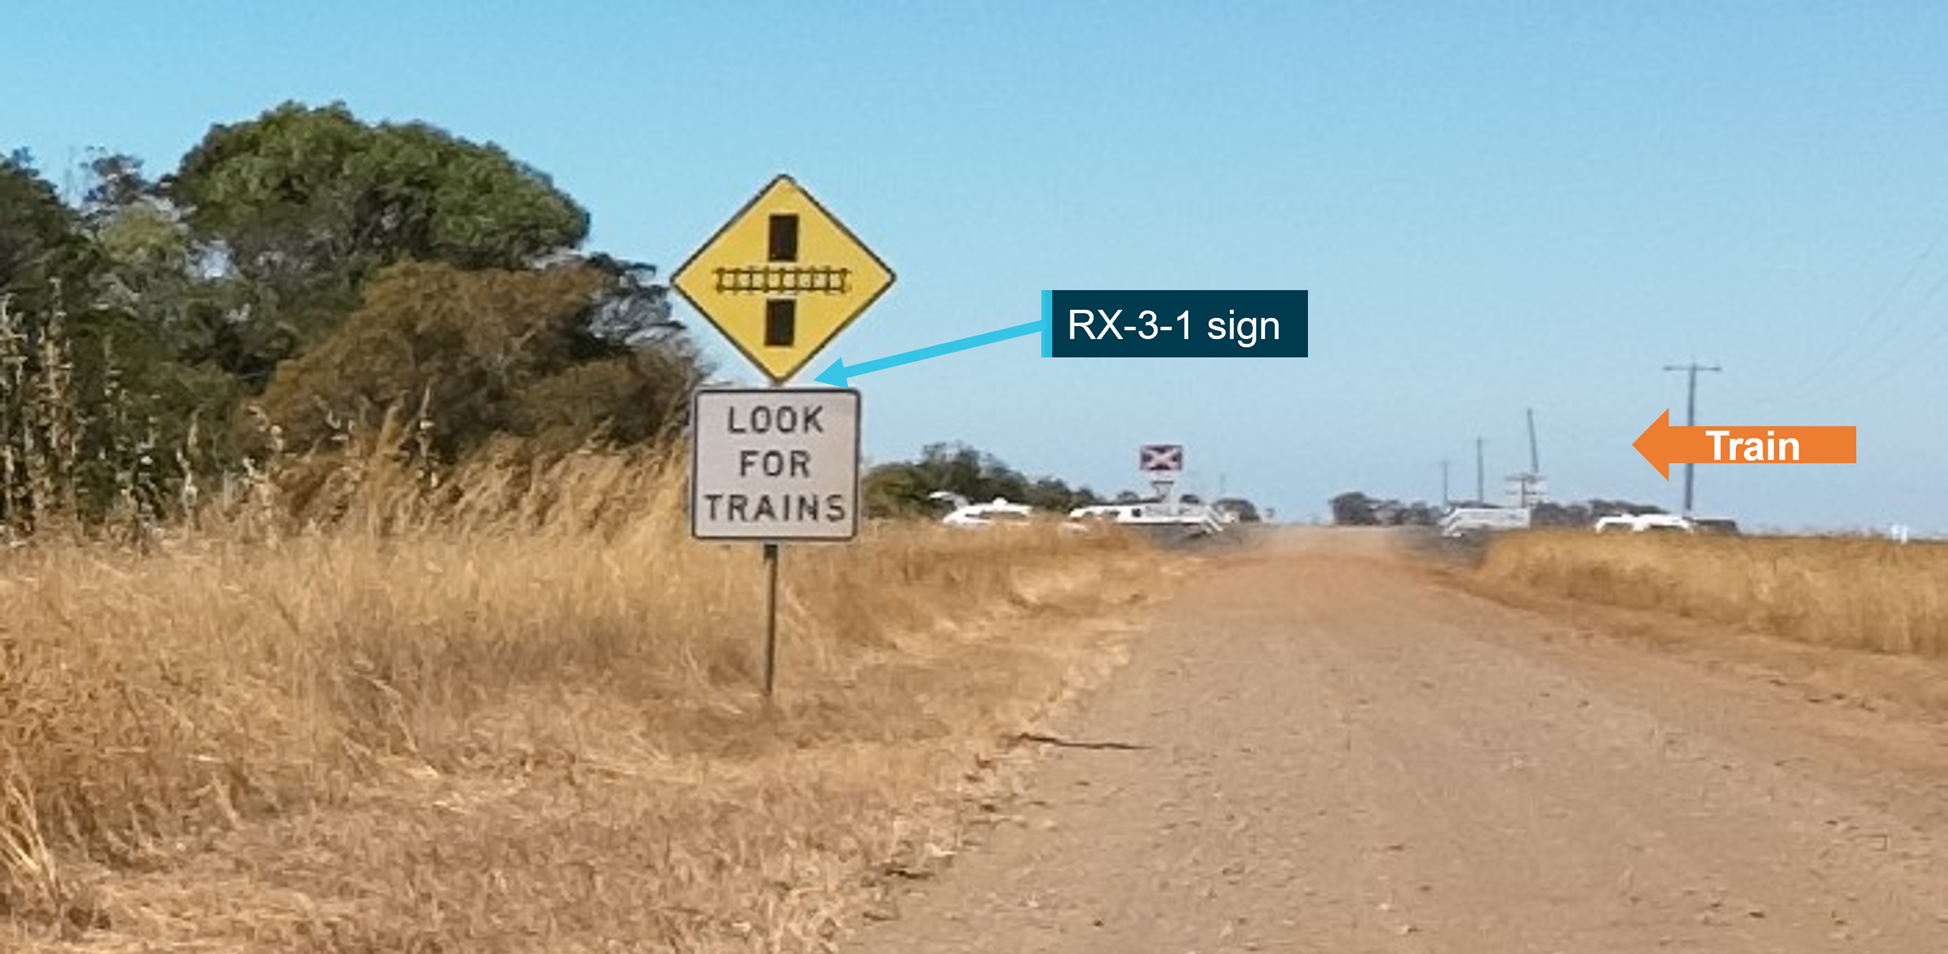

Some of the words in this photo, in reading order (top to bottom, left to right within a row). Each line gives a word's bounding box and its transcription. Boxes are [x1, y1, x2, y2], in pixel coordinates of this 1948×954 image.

[727, 405, 823, 434] LOOK
[740, 450, 811, 477] FOR
[704, 494, 845, 522] TRAINS
